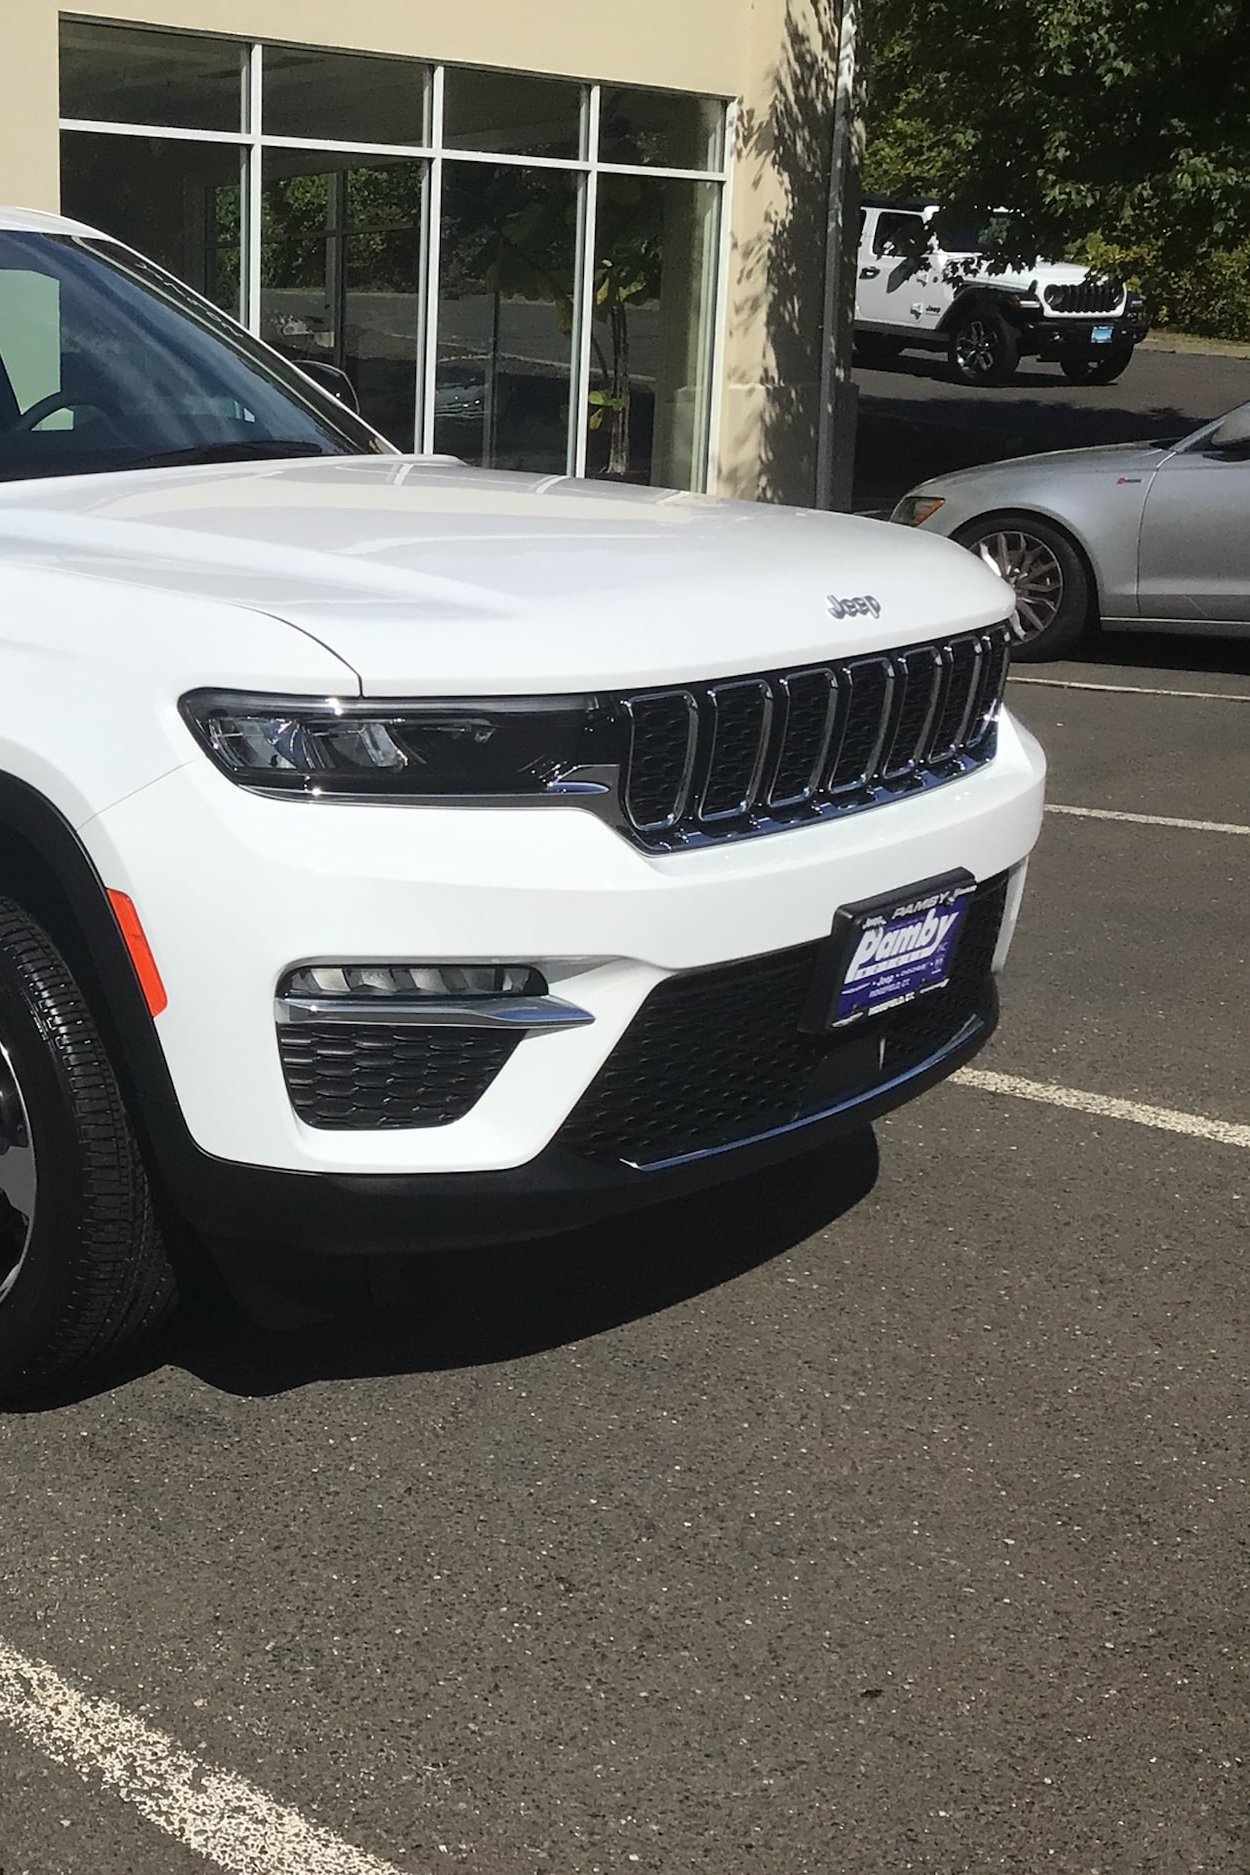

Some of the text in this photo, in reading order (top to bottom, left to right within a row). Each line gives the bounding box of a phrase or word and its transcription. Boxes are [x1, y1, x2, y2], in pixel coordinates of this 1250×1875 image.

[826, 594, 881, 620] Jeep
[892, 891, 951, 919] PAMBY
[844, 908, 960, 985] Pamby
